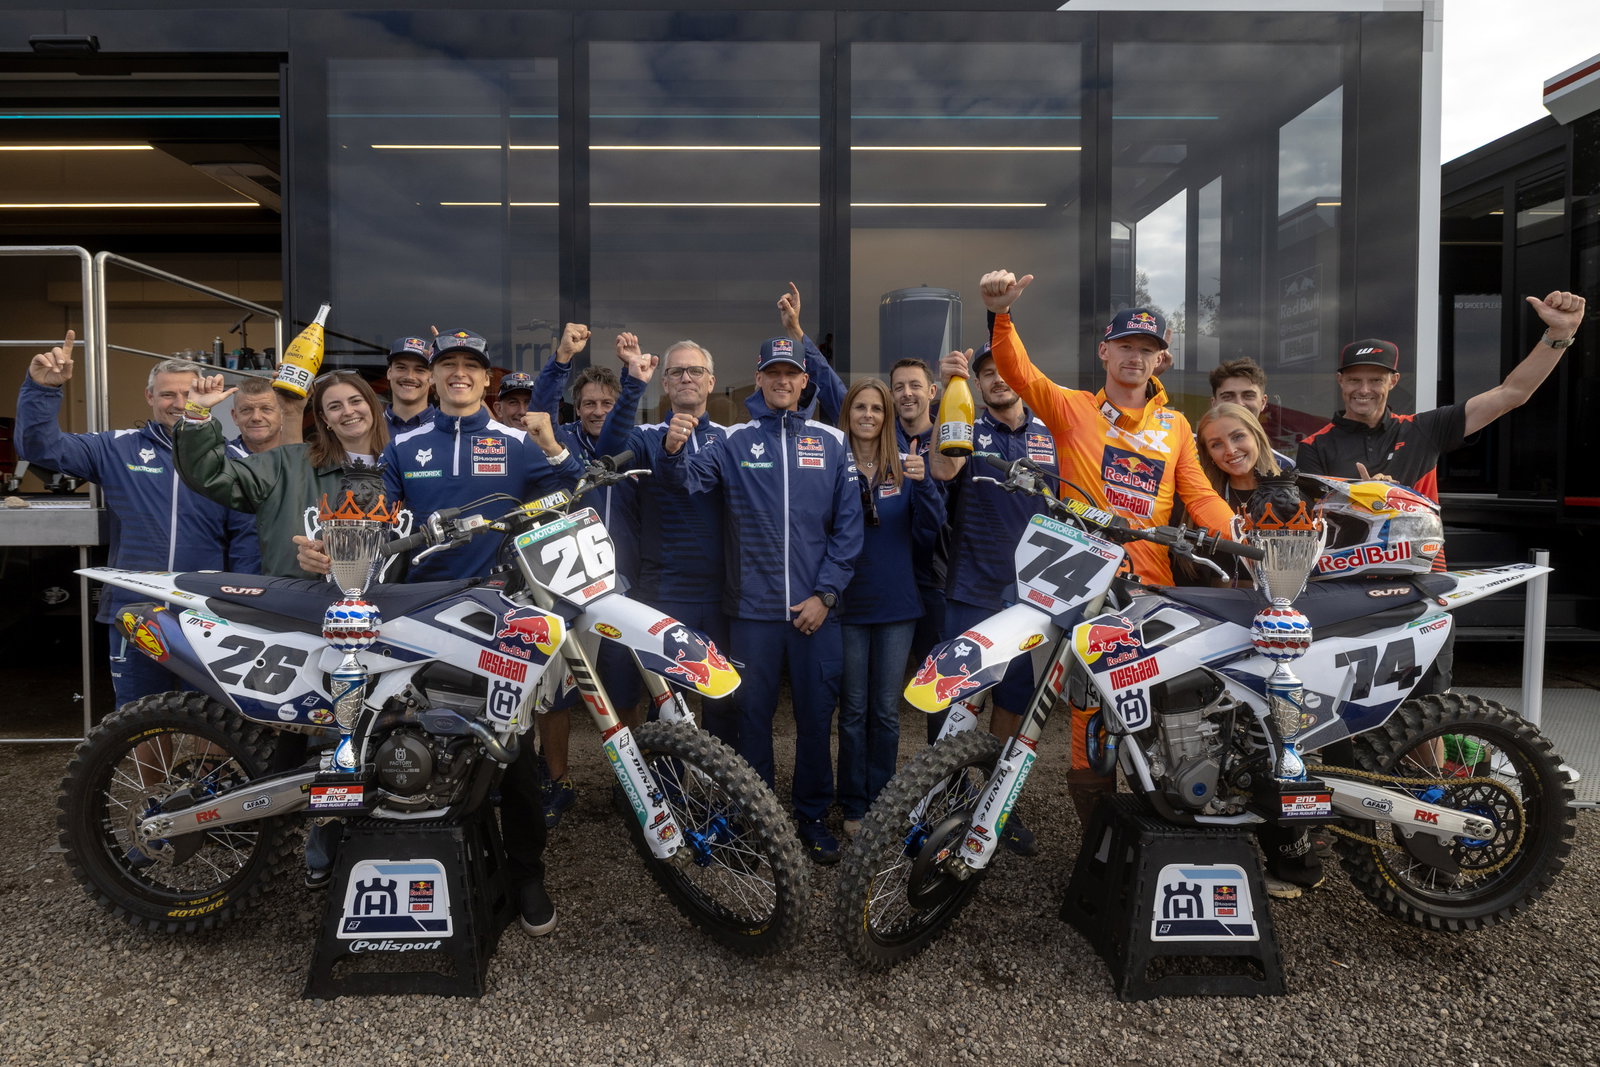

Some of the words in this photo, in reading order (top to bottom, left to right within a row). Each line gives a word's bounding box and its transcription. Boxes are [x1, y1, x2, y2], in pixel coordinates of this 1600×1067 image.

[1356, 347, 1383, 355] WP
[278, 375, 306, 388] NTERO
[473, 446, 489, 454] Red
[489, 446, 505, 454] Bull
[134, 466, 163, 474] MOTOREX
[412, 470, 441, 478] MOTOREX
[1104, 466, 1132, 483] Red
[1132, 472, 1157, 492] Bull
[529, 521, 566, 542] MOTOREX
[1042, 519, 1079, 539] MOTOREX
[1422, 543, 1439, 552] BELL
[540, 522, 615, 595] 26
[1319, 547, 1364, 573] Red
[1365, 541, 1411, 565] Bull
[1018, 530, 1110, 602] 74
[1486, 573, 1525, 588] DUNLOP
[220, 585, 265, 595] GUTS
[1368, 587, 1411, 597] GUTS
[186, 617, 217, 630] MX2
[1419, 619, 1448, 635] MXGP
[499, 642, 516, 655] Red
[516, 646, 531, 660] Bull
[1107, 654, 1123, 666] Red
[1124, 649, 1139, 661] Bull
[207, 634, 309, 696] 26
[1335, 637, 1422, 702] 74
[631, 758, 654, 793] DUNL
[613, 762, 647, 815] MOTOREX
[983, 766, 1008, 814] DUNLO
[1004, 759, 1034, 813] MOTOREX
[246, 799, 267, 809] AFAM
[1366, 800, 1387, 810] AFAM
[195, 808, 220, 821] RK
[1414, 809, 1440, 823] RK
[167, 898, 225, 918] DUNLOP
[354, 939, 442, 952] Polisport
